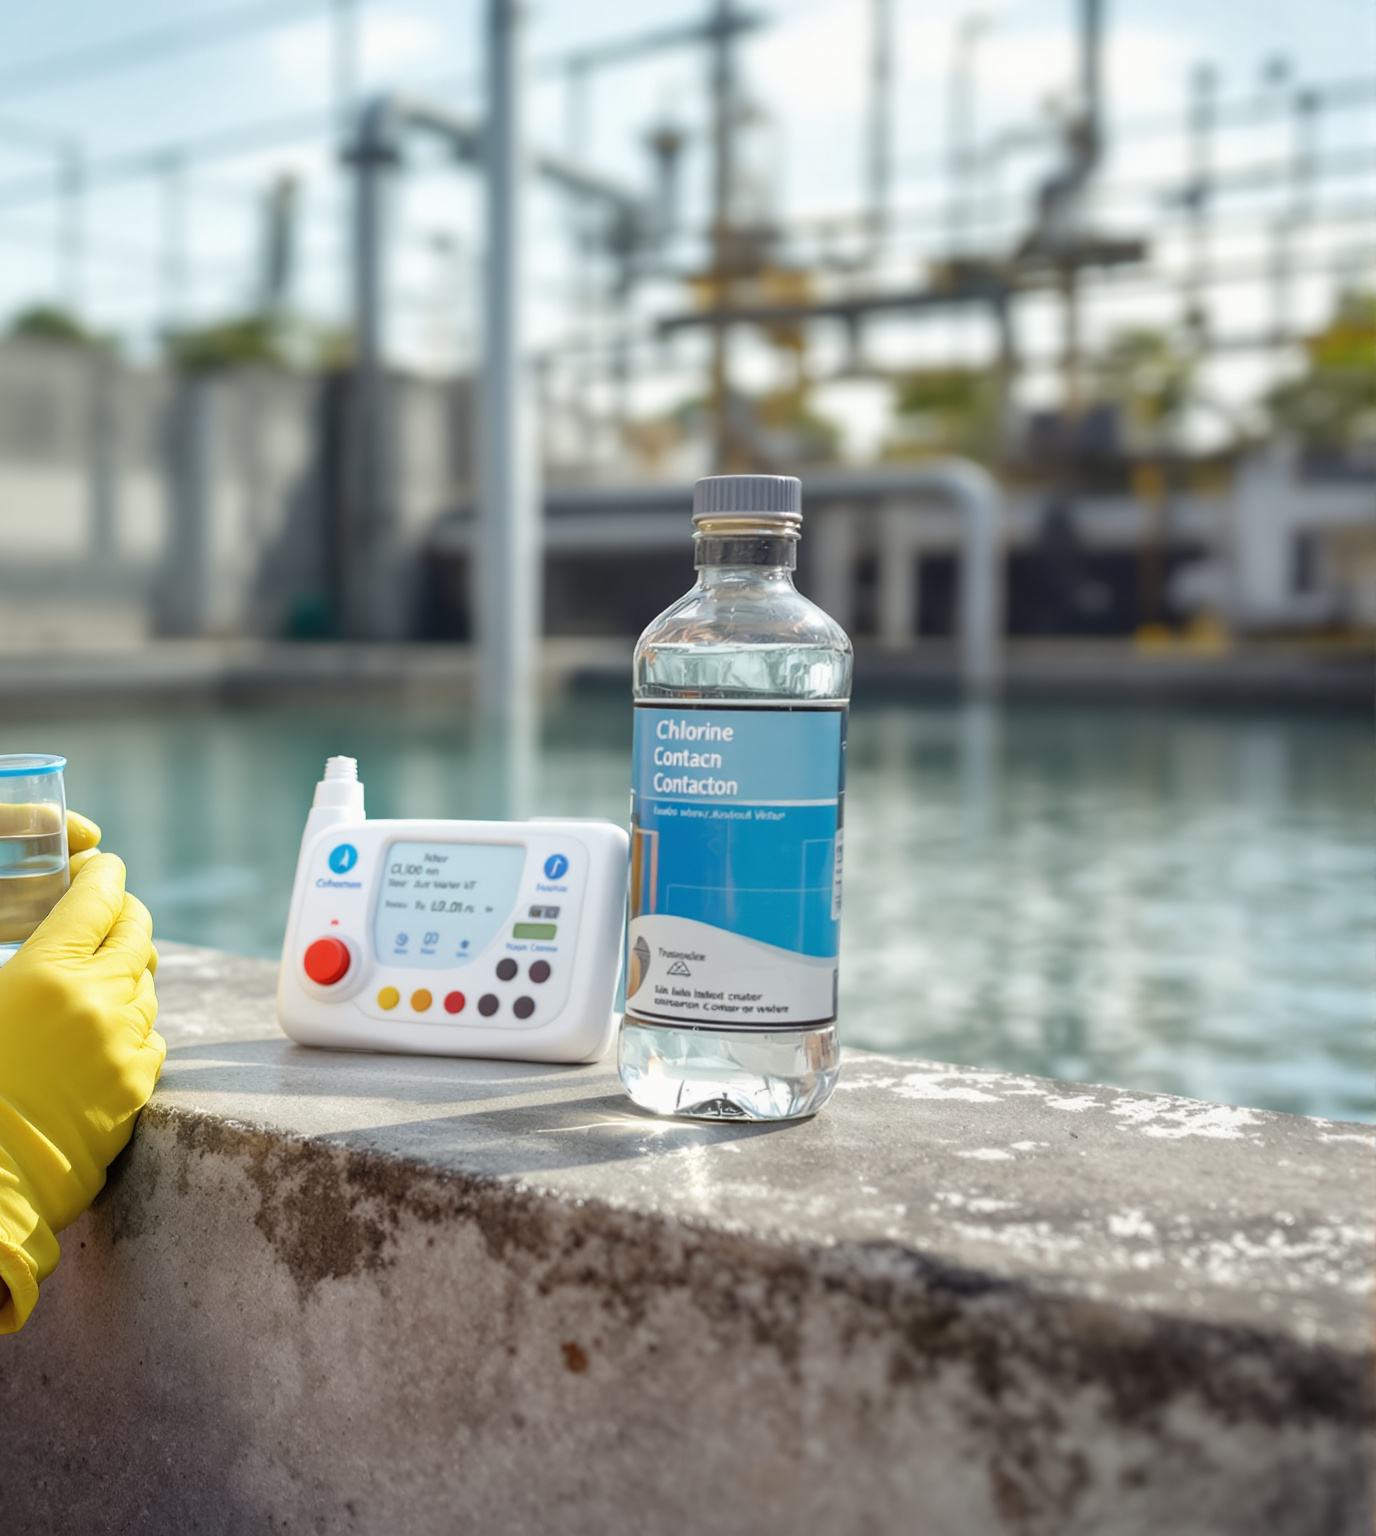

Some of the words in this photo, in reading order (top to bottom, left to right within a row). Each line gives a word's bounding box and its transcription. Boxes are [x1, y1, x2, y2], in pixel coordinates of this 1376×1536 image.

[656, 718, 734, 742] Chlorine
[653, 746, 722, 769] Contacn
[653, 772, 738, 796] Contacton
